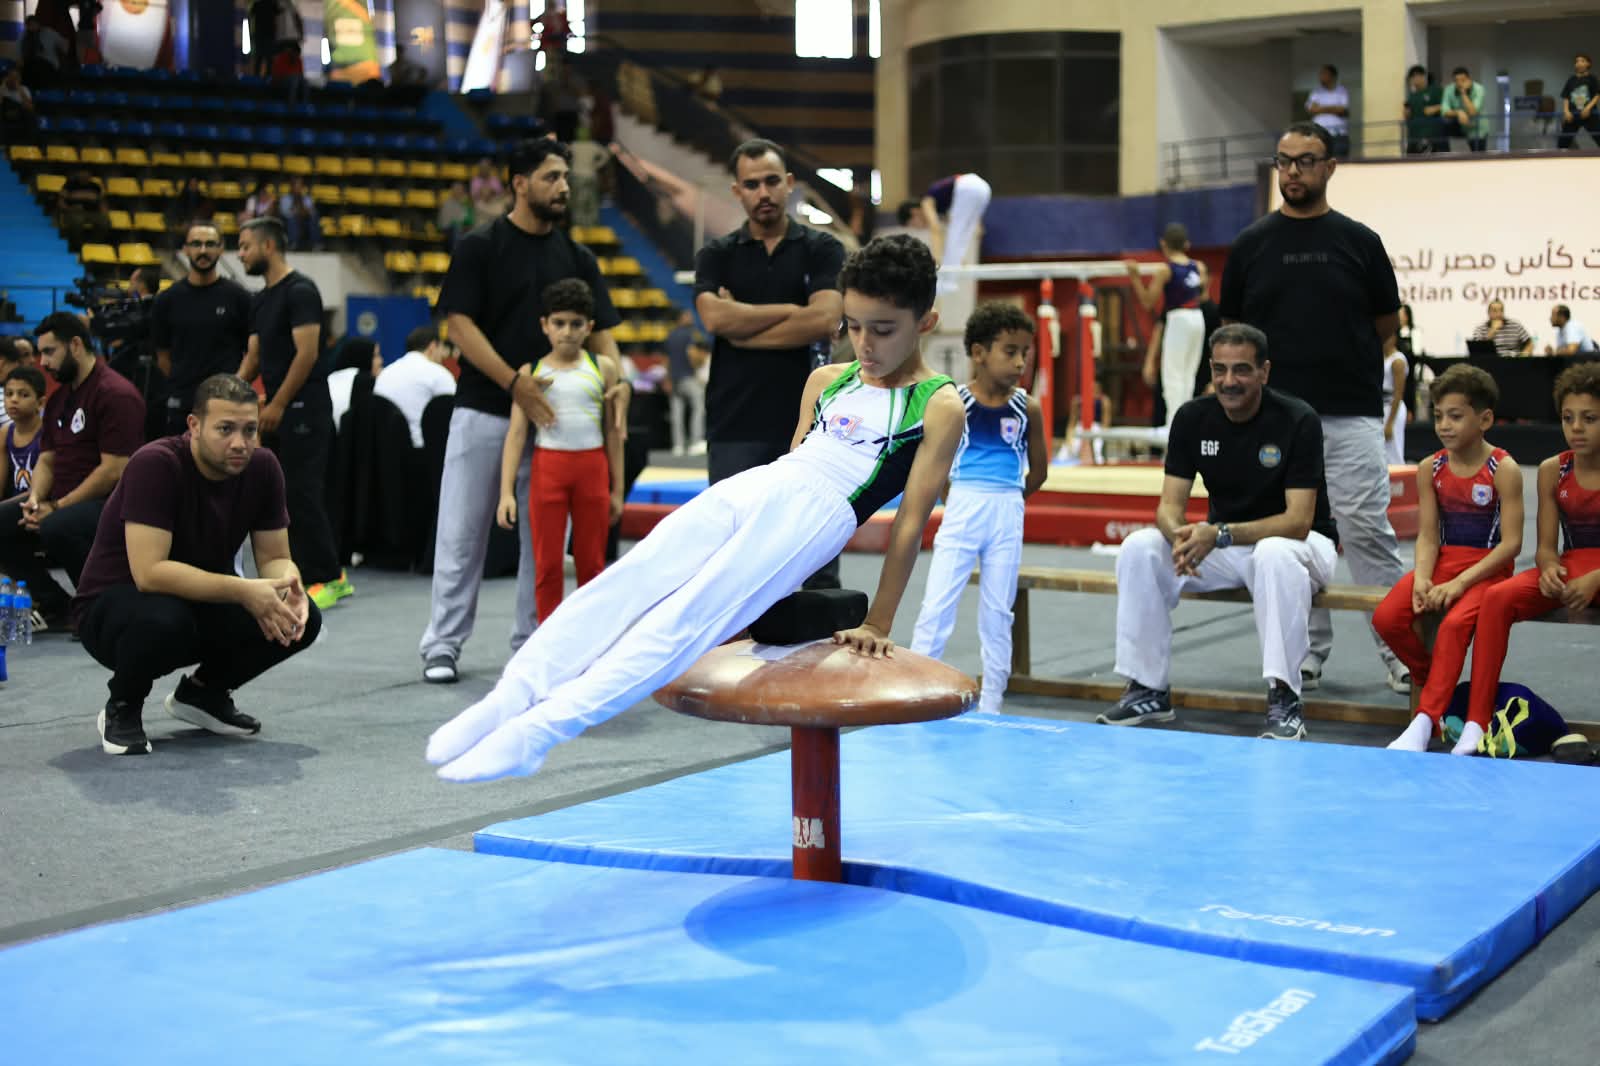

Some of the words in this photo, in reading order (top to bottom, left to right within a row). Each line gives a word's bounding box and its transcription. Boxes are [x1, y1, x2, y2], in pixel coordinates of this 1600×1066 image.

[1441, 252, 1495, 278] مصر
[1463, 280, 1600, 304] Gymnastics
[1200, 440, 1219, 456] EGF
